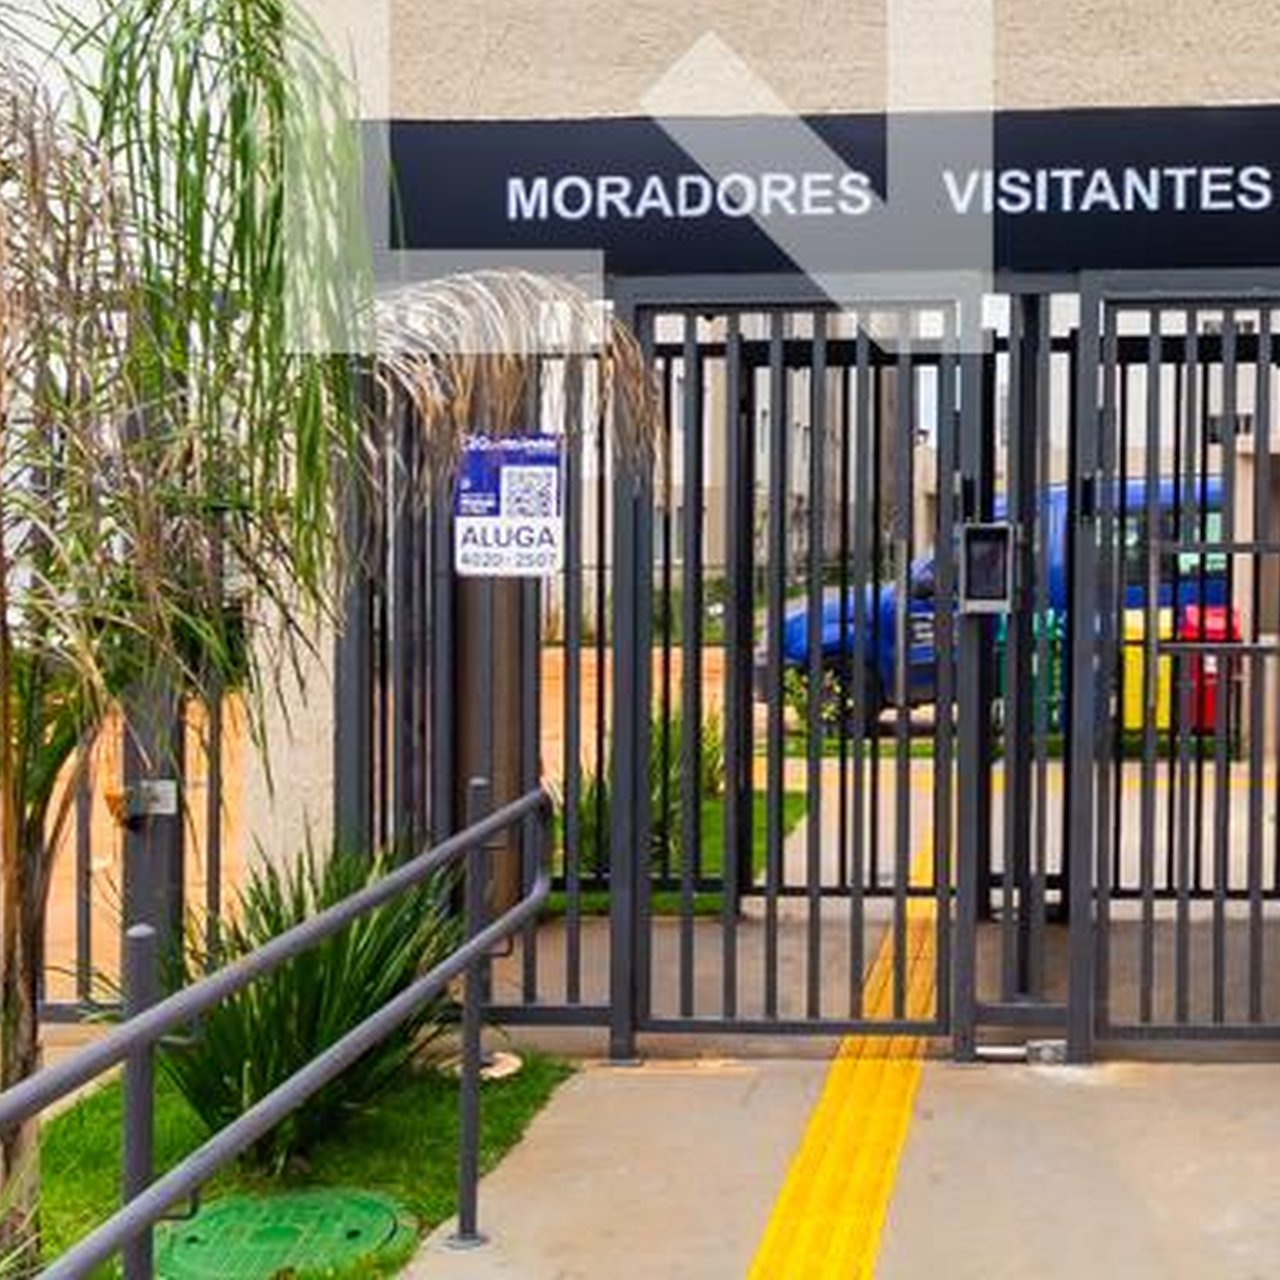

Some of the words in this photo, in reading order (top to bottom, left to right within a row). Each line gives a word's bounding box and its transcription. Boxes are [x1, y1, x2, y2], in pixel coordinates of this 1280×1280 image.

[506, 172, 872, 222] MORADORES
[943, 165, 1274, 214] VISITANTES
[461, 526, 556, 548] ALUGA
